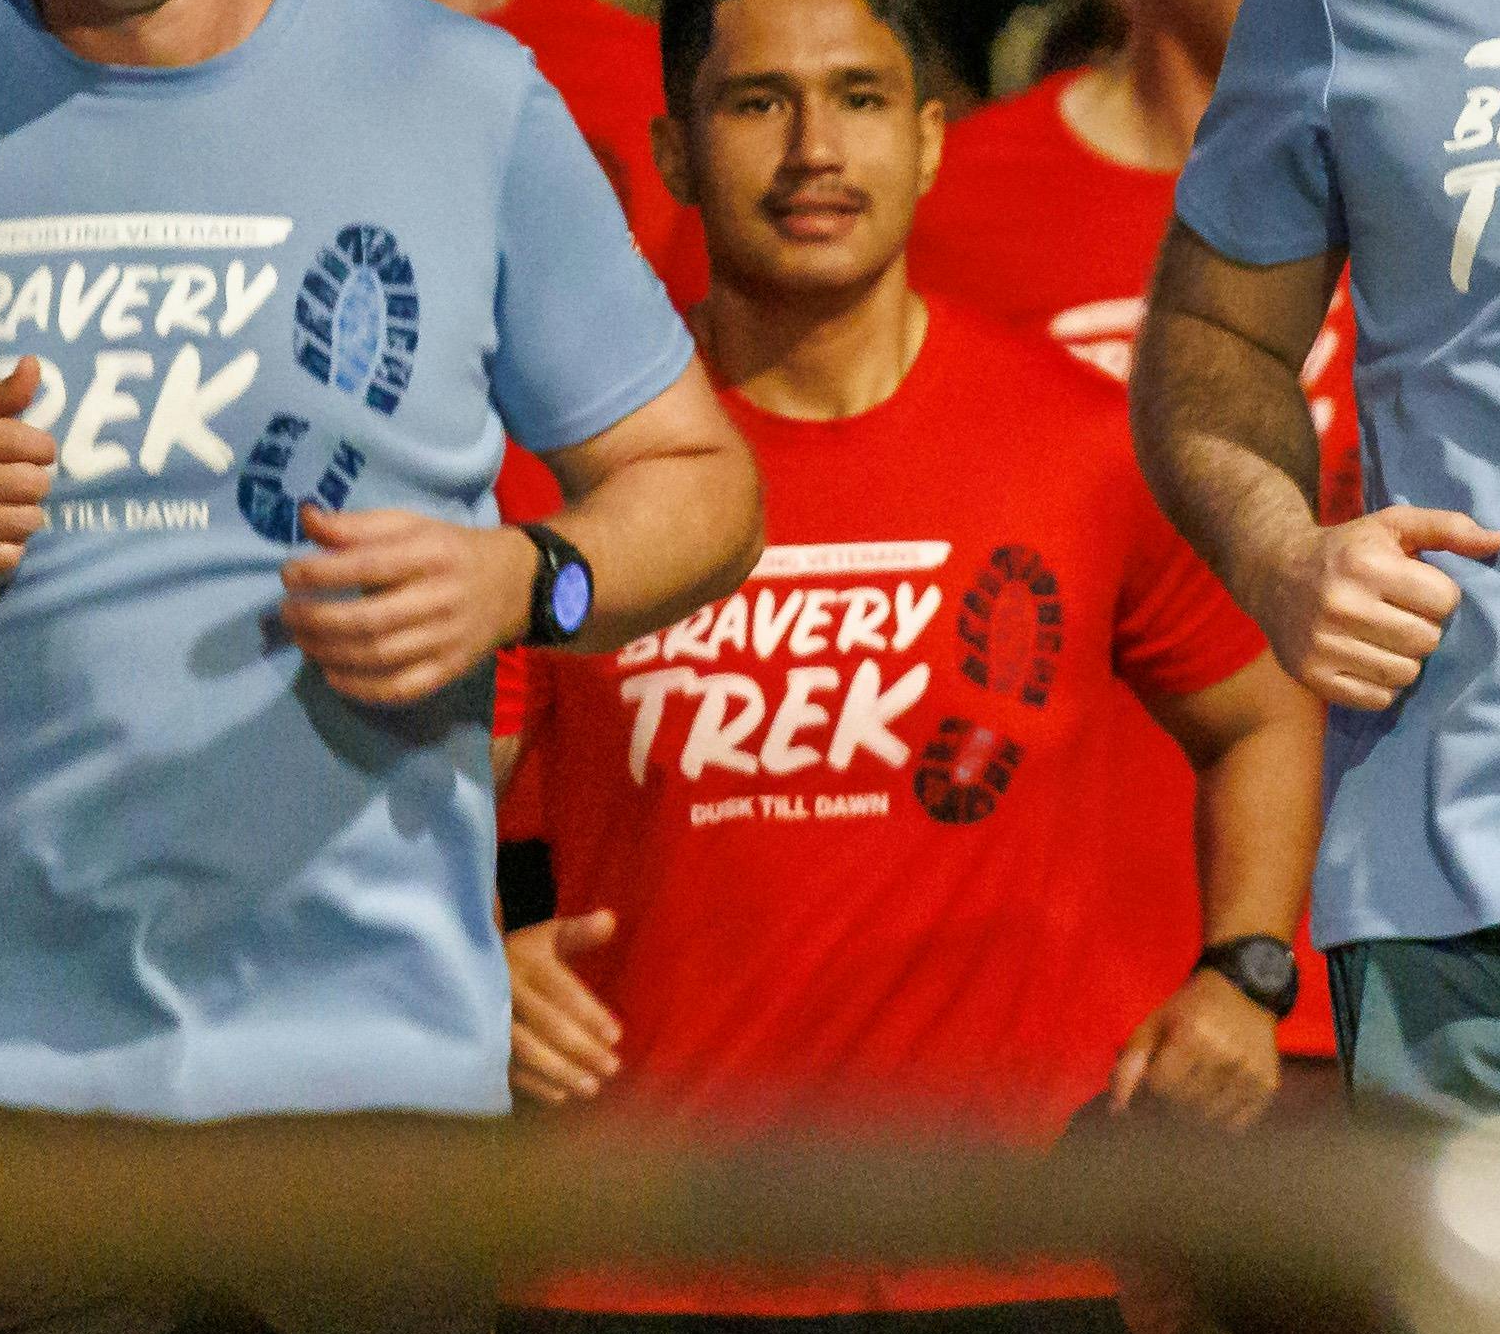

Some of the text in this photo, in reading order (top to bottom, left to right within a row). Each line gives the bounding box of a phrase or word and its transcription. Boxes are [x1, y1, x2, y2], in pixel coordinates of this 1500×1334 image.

[65, 501, 116, 532] TILL
[126, 499, 210, 531] DAWN
[619, 659, 931, 788] TREK
[758, 794, 809, 819] TILL
